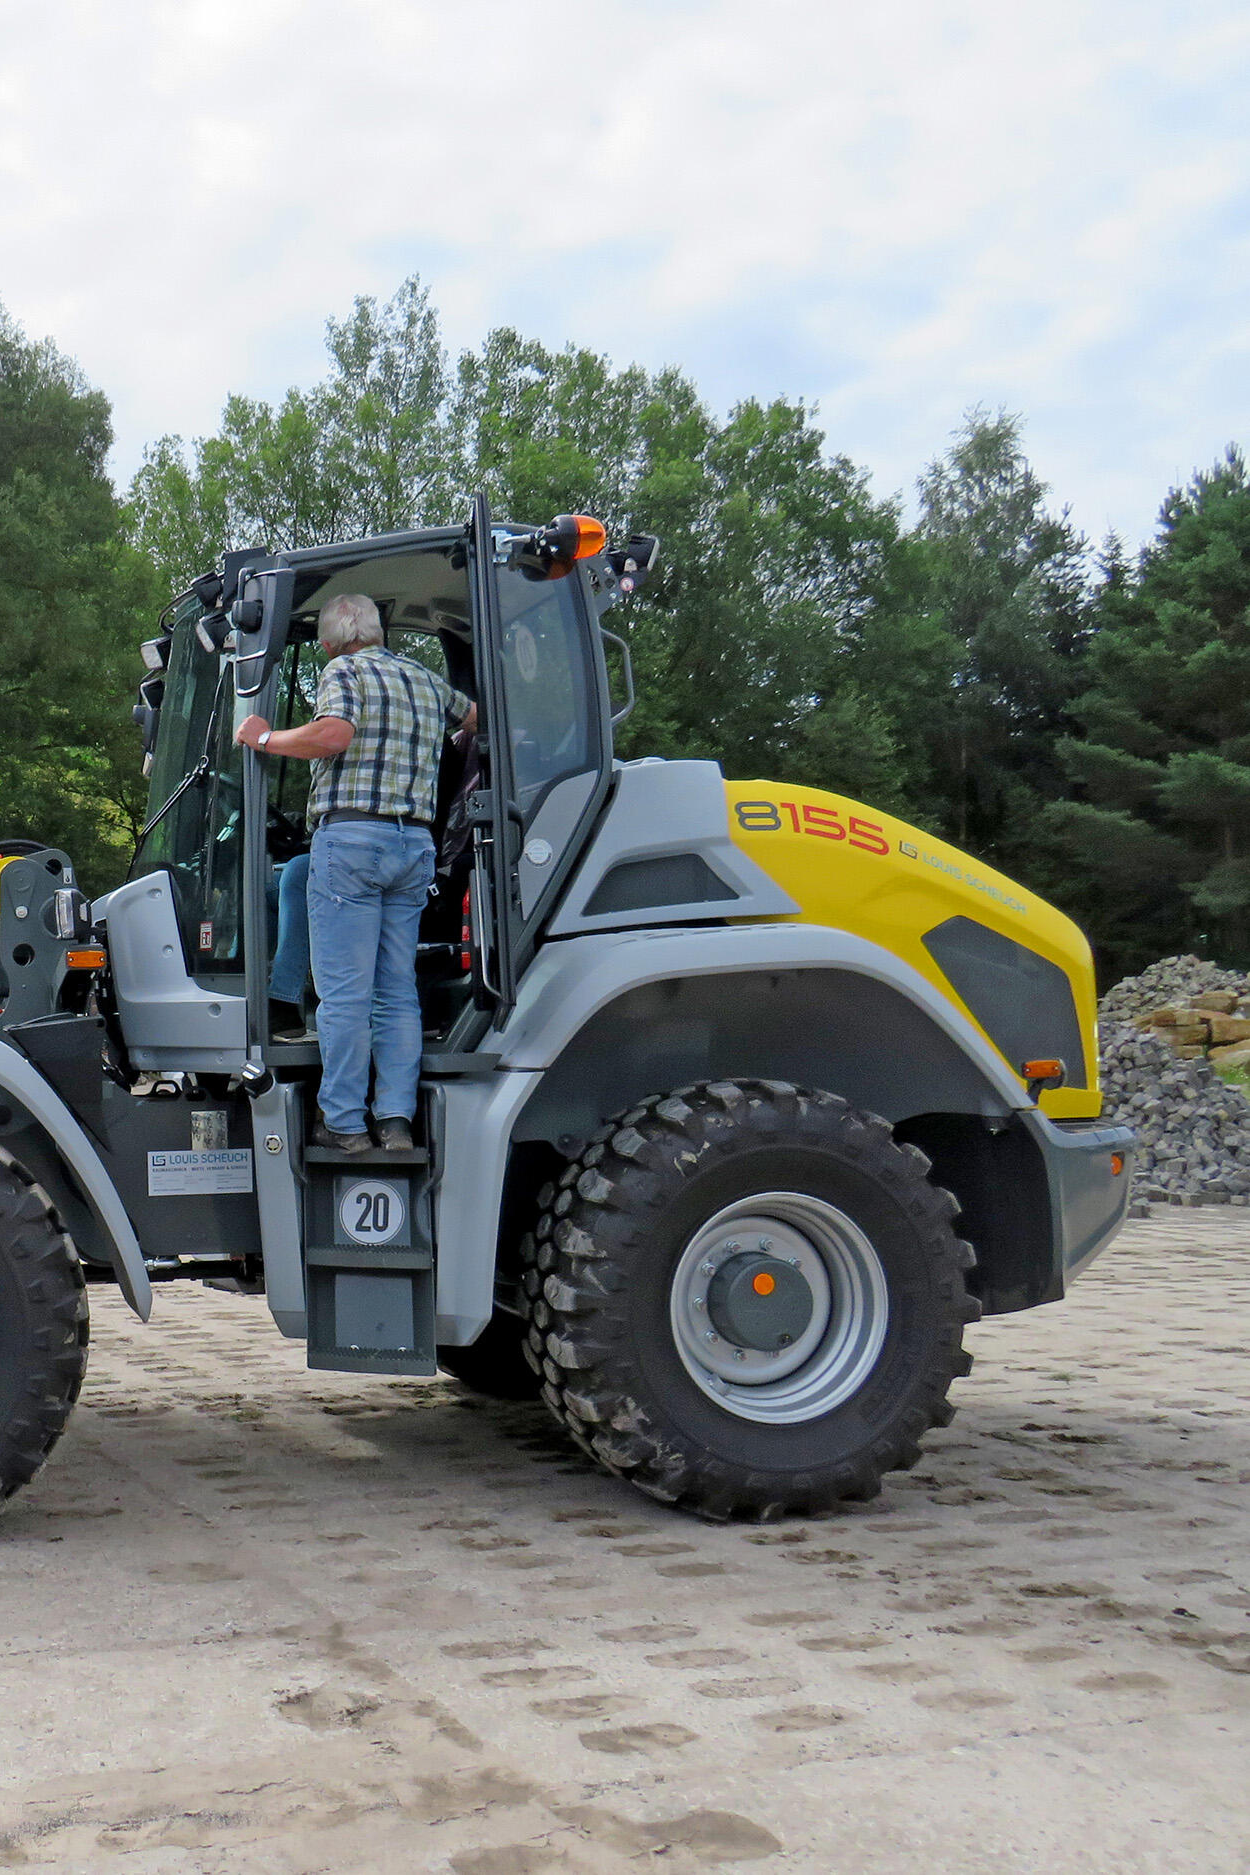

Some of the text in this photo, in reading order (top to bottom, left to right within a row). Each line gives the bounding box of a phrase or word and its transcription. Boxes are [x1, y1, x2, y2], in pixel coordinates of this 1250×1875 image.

[734, 800, 890, 856] 8155
[922, 851, 963, 880] LOUIS
[169, 1154, 199, 1165] LOUIS
[201, 1152, 248, 1164] SCHEUCH
[354, 1192, 390, 1233] 20
